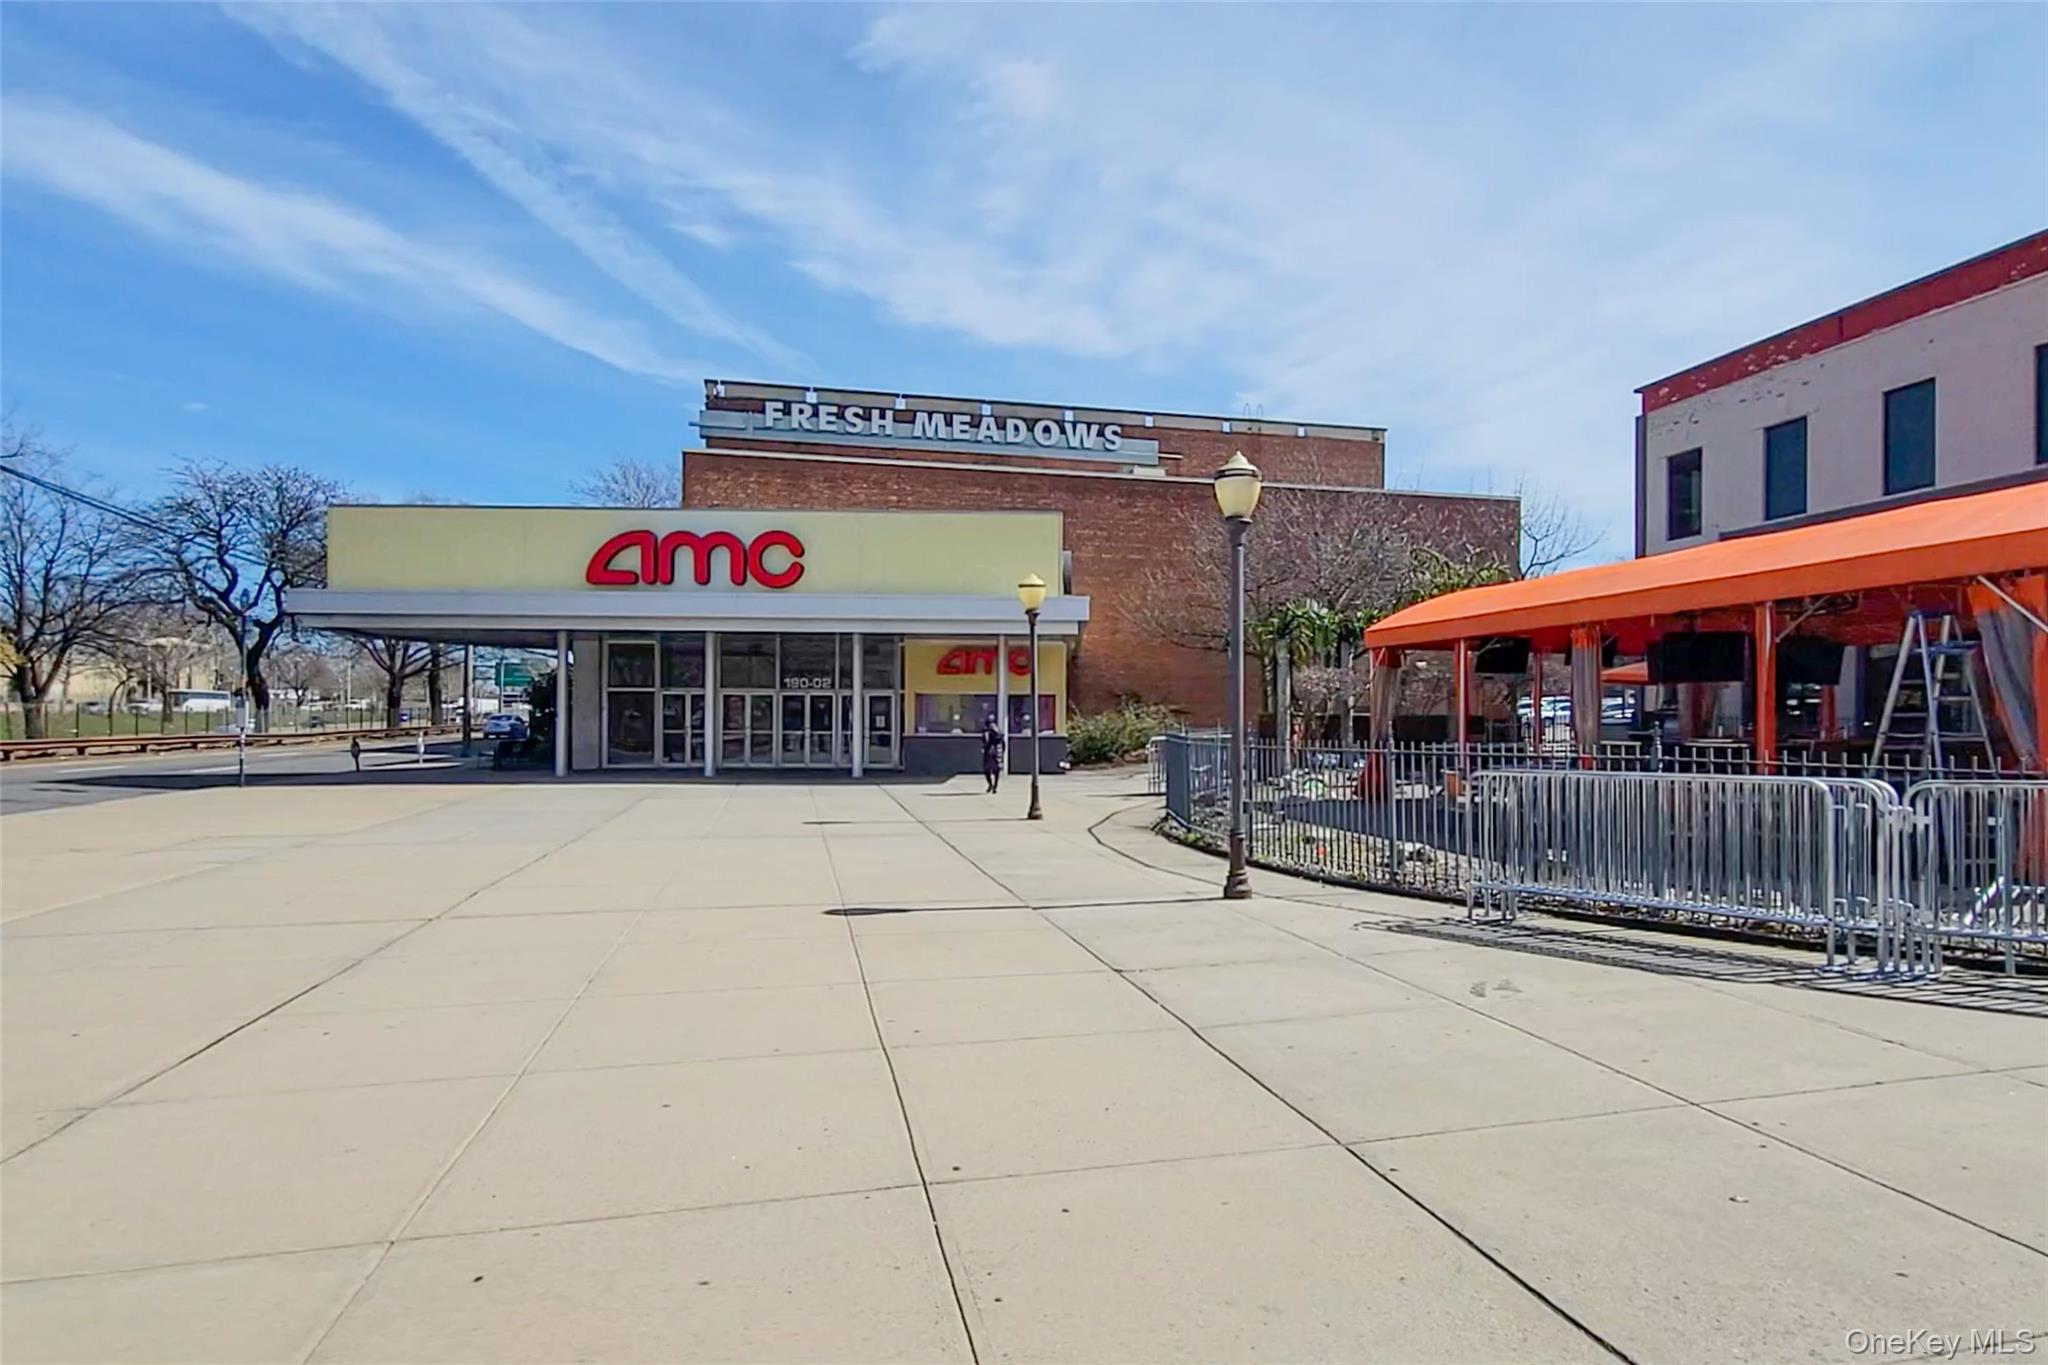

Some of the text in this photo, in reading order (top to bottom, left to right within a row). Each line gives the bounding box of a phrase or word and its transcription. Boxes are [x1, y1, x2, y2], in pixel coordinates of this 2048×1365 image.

[763, 401, 1125, 452] FRESH MEADOWS
[783, 676, 832, 689] 190-02
